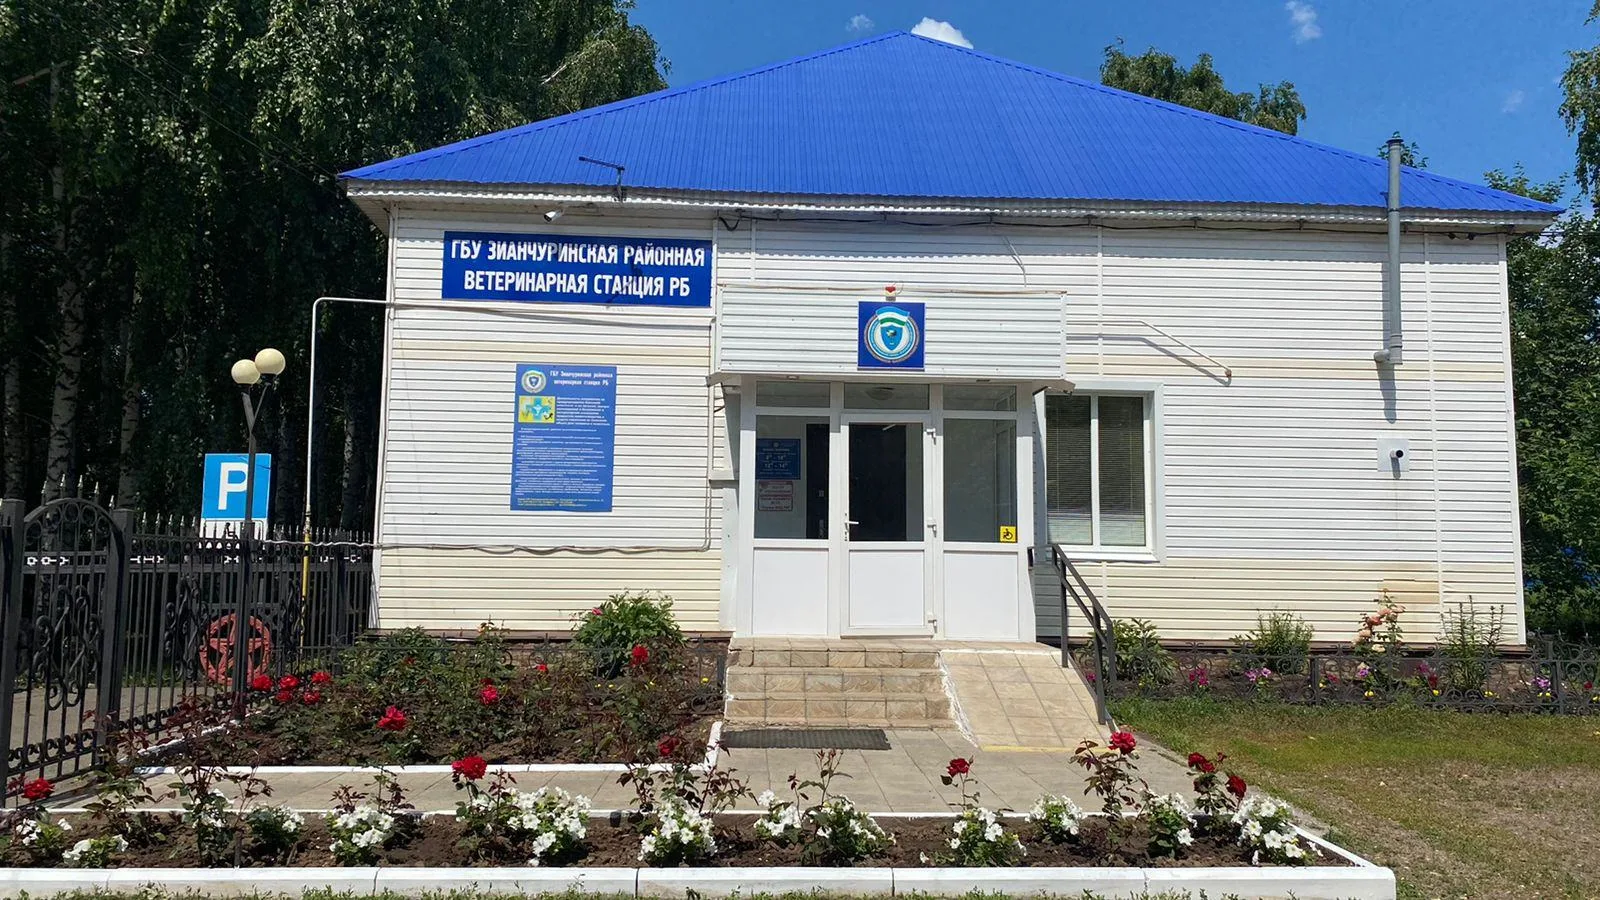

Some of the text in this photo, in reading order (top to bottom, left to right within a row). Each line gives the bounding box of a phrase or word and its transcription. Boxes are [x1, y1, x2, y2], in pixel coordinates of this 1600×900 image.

[451, 239, 705, 267] ГБУ ЗИАНЧУРИНСКАЯ РАЙОННАЯ
[464, 270, 690, 298] ВЕТЕРИНАРНАЯ СТАНЦИЯ РБ
[218, 462, 248, 510] P
